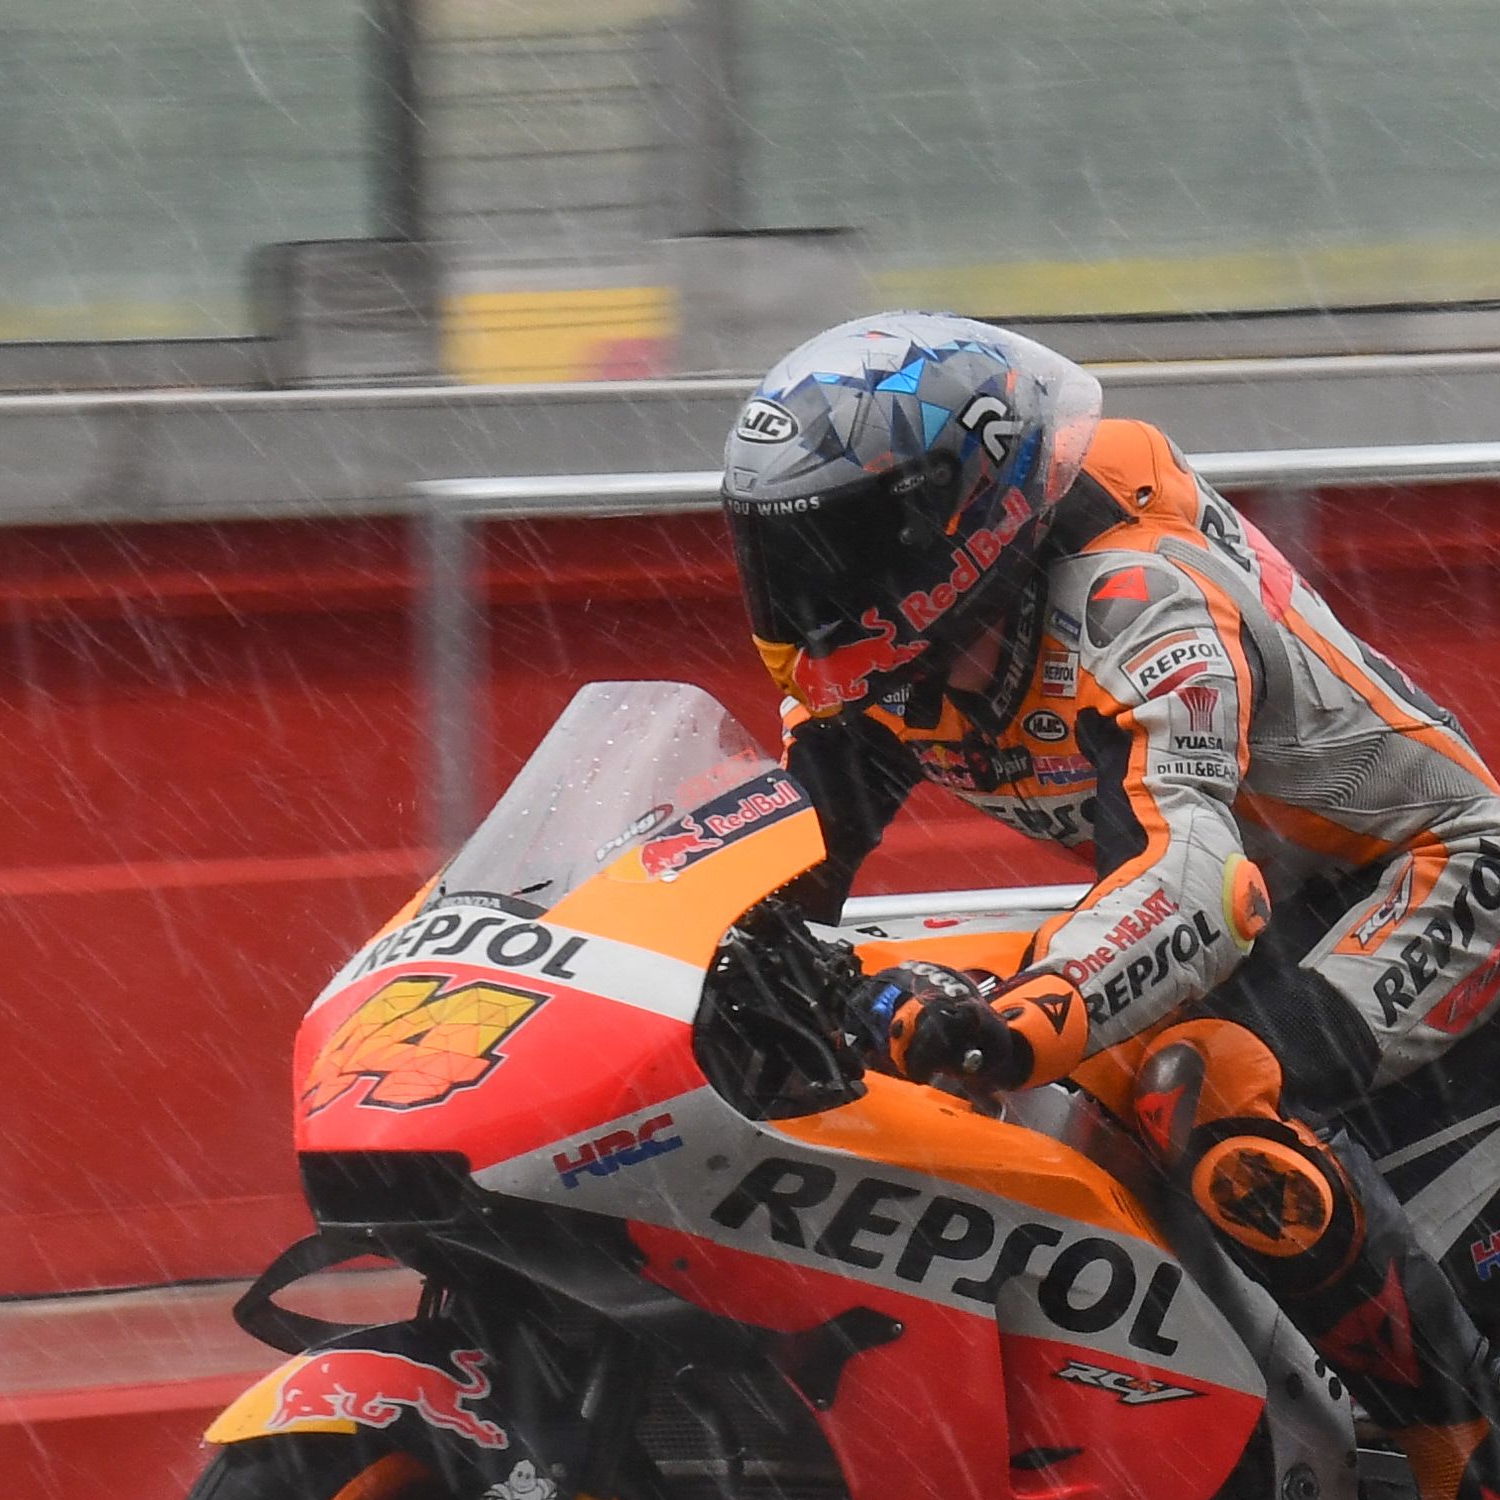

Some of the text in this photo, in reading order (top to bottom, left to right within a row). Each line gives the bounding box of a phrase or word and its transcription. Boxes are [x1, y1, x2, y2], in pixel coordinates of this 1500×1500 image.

[740, 408, 788, 437] JC
[756, 496, 820, 516] WINGS
[898, 546, 980, 632] Red
[965, 486, 1032, 571] Bull
[1138, 643, 1224, 687] REPSOL
[1174, 735, 1224, 750] YUASA
[705, 780, 801, 836] Red Bull
[352, 914, 589, 980] REPSOL
[1063, 946, 1115, 985] One
[1085, 909, 1221, 1026] REPSOL
[553, 1112, 683, 1190] HRC
[710, 1156, 1184, 1356] REPSOL
